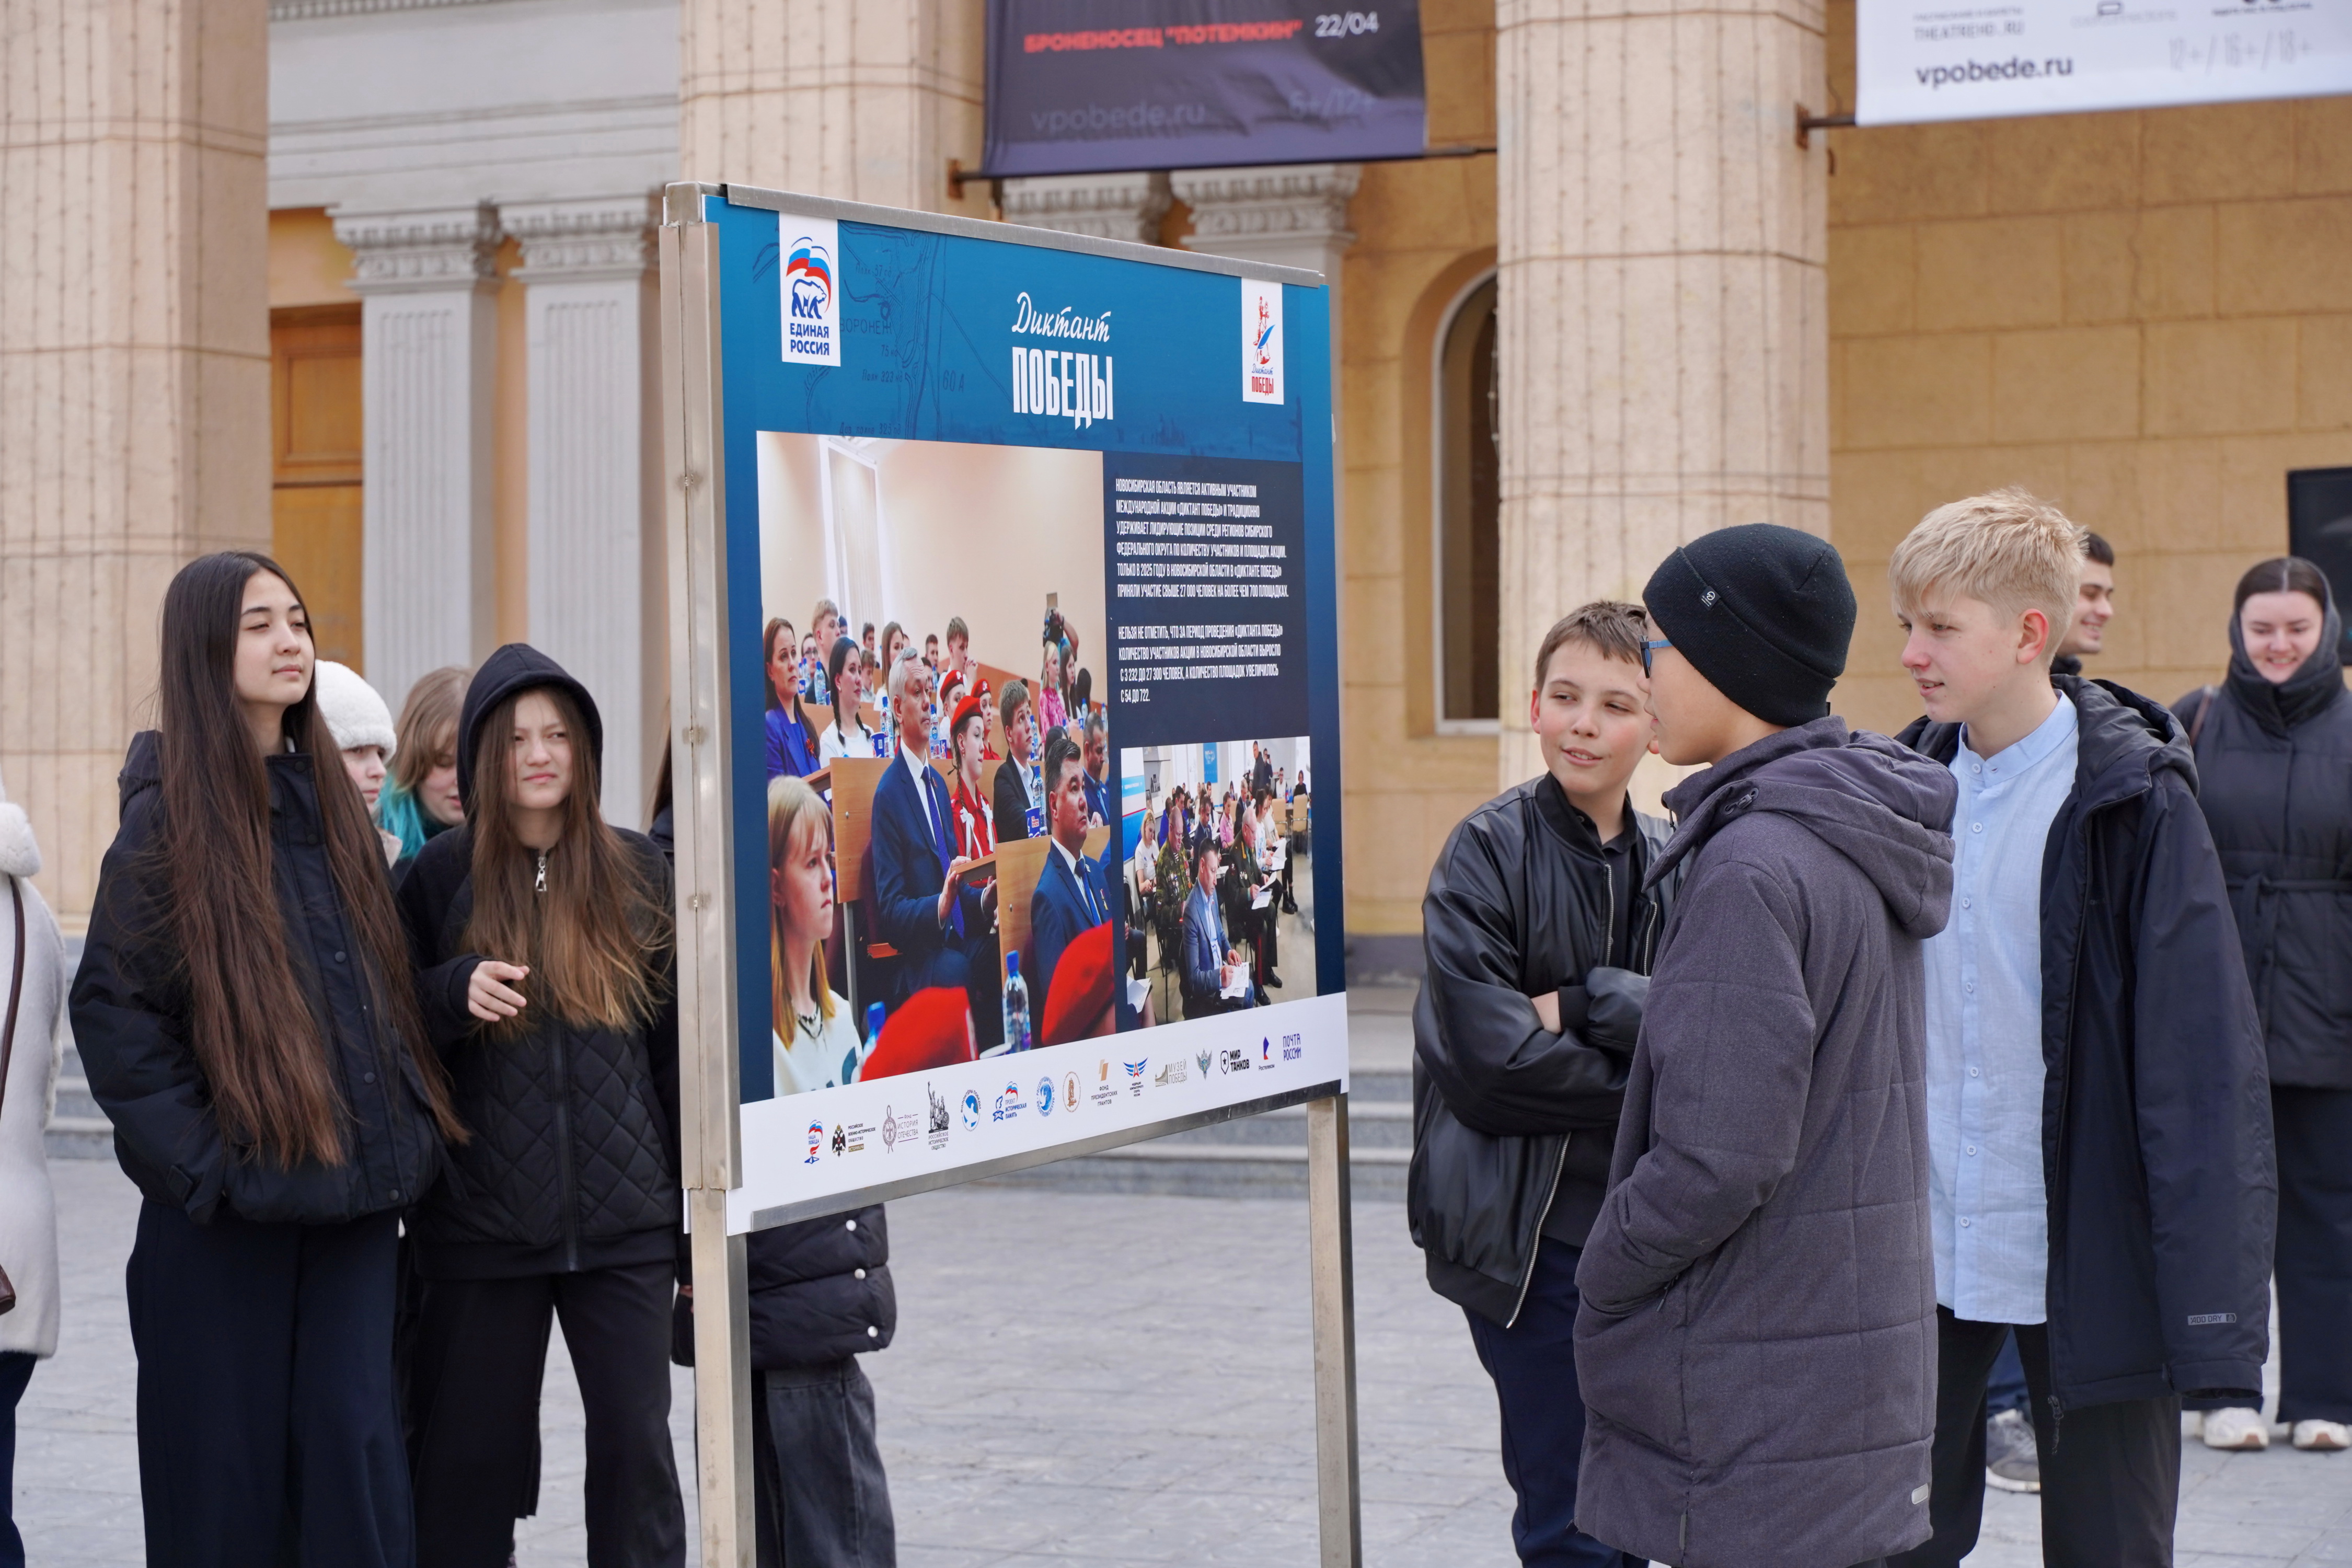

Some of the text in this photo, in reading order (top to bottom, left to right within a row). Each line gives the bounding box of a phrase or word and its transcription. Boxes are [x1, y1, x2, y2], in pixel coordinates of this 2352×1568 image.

[1024, 11, 1379, 53] БРОНЕНОСЕЦ "ПОТЕМКИН" 22/04
[1916, 55, 2073, 90] vpobede.ru
[1031, 101, 1205, 133] vpobede.ru
[1012, 292, 1111, 342] Диктант
[790, 322, 829, 339] ЕДИНАЯ
[790, 339, 829, 356] РОССИЯ
[1251, 363, 1274, 375] Диктант
[1012, 347, 1113, 430] ПОБЕДЫ
[1252, 376, 1274, 396] ПОБЕДЫ
[1116, 479, 1256, 498] НОВОСИБИРСКАЯ ОБЛАСТЬ ЯВЛЯЕТСЯ АКТИВНЫМ УЧАСТНИКОМ
[1116, 499, 1260, 518] МЕЖДУНАРОДНОЙ АКЦИИ «ДИКТАНТ ПОБЕДЫ» И ТРАДИЦИОННО
[1116, 521, 1272, 538] УДЕРЖИВАЕТ ЛИДИРУЮЩИЕ ПОЗИЦИИ СРЕДИ РЕГИОНОВ СИБИРСКОГО
[1116, 542, 1287, 559] ФЕДЕРАЛЬНОГО ОКРУГА ПО КОЛИЧЕСТВУ УЧАСТНИКОВ И ПЛОЩАДОК АКЦИИ.
[1117, 562, 1282, 579] ТОЛЬКО В 2025 ГОДУ В НОВОСИБИРСКОЙ ОБЛАСТИ В «ДИКТАНТЕ ПОБЕДЫ»
[1117, 584, 1289, 598] ПРИНЯЛИ УЧАСТИЕ СВЫШЕ 27 000 ЧЕЛОВЕК НА БОЛЕЕ ЧЕМ 700 ПЛОЩАДКАХ.
[1119, 624, 1283, 640] НЕЛЬЗЯ НЕ ОТМЕТИТЬ, ЧТО ЗА ПЕРИОД ПРОВЕДЕНИЯ «ДИКТАНТА ПОБЕДЫ»
[1119, 643, 1281, 660] КОЛИЧЕСТВО УЧАСТНИКОВ АКЦИИ В НОВОСИБИРСКОЙ ОБЛАСТИ ВЫРОСЛО
[1120, 664, 1278, 682] С 3 232 ДО 27 300 ЧЕЛОВЕК, А КОЛИЧЕСТВО ПЛОЩАДОК УВЕЛИЧИЛОСЬ
[1121, 688, 1150, 704] С 54 ДО 722.
[1283, 1033, 1301, 1047] ПОЧТА
[1230, 1050, 1240, 1061] МИР
[1284, 1047, 1301, 1061] РОССИИ
[1169, 1059, 1186, 1073] МУЗЕЙ
[1230, 1059, 1249, 1072] ТАНКОВ
[1169, 1071, 1187, 1085] ПОБЕДЫ
[1091, 1090, 1117, 1100] ПРЕЗИДЕНТСКИХ
[1005, 1103, 1027, 1112] ИСТОРИЧЕСКАЯ
[897, 1120, 918, 1129] ИСТОРИЯ
[898, 1129, 918, 1139] ОТЕЧЕСТВА
